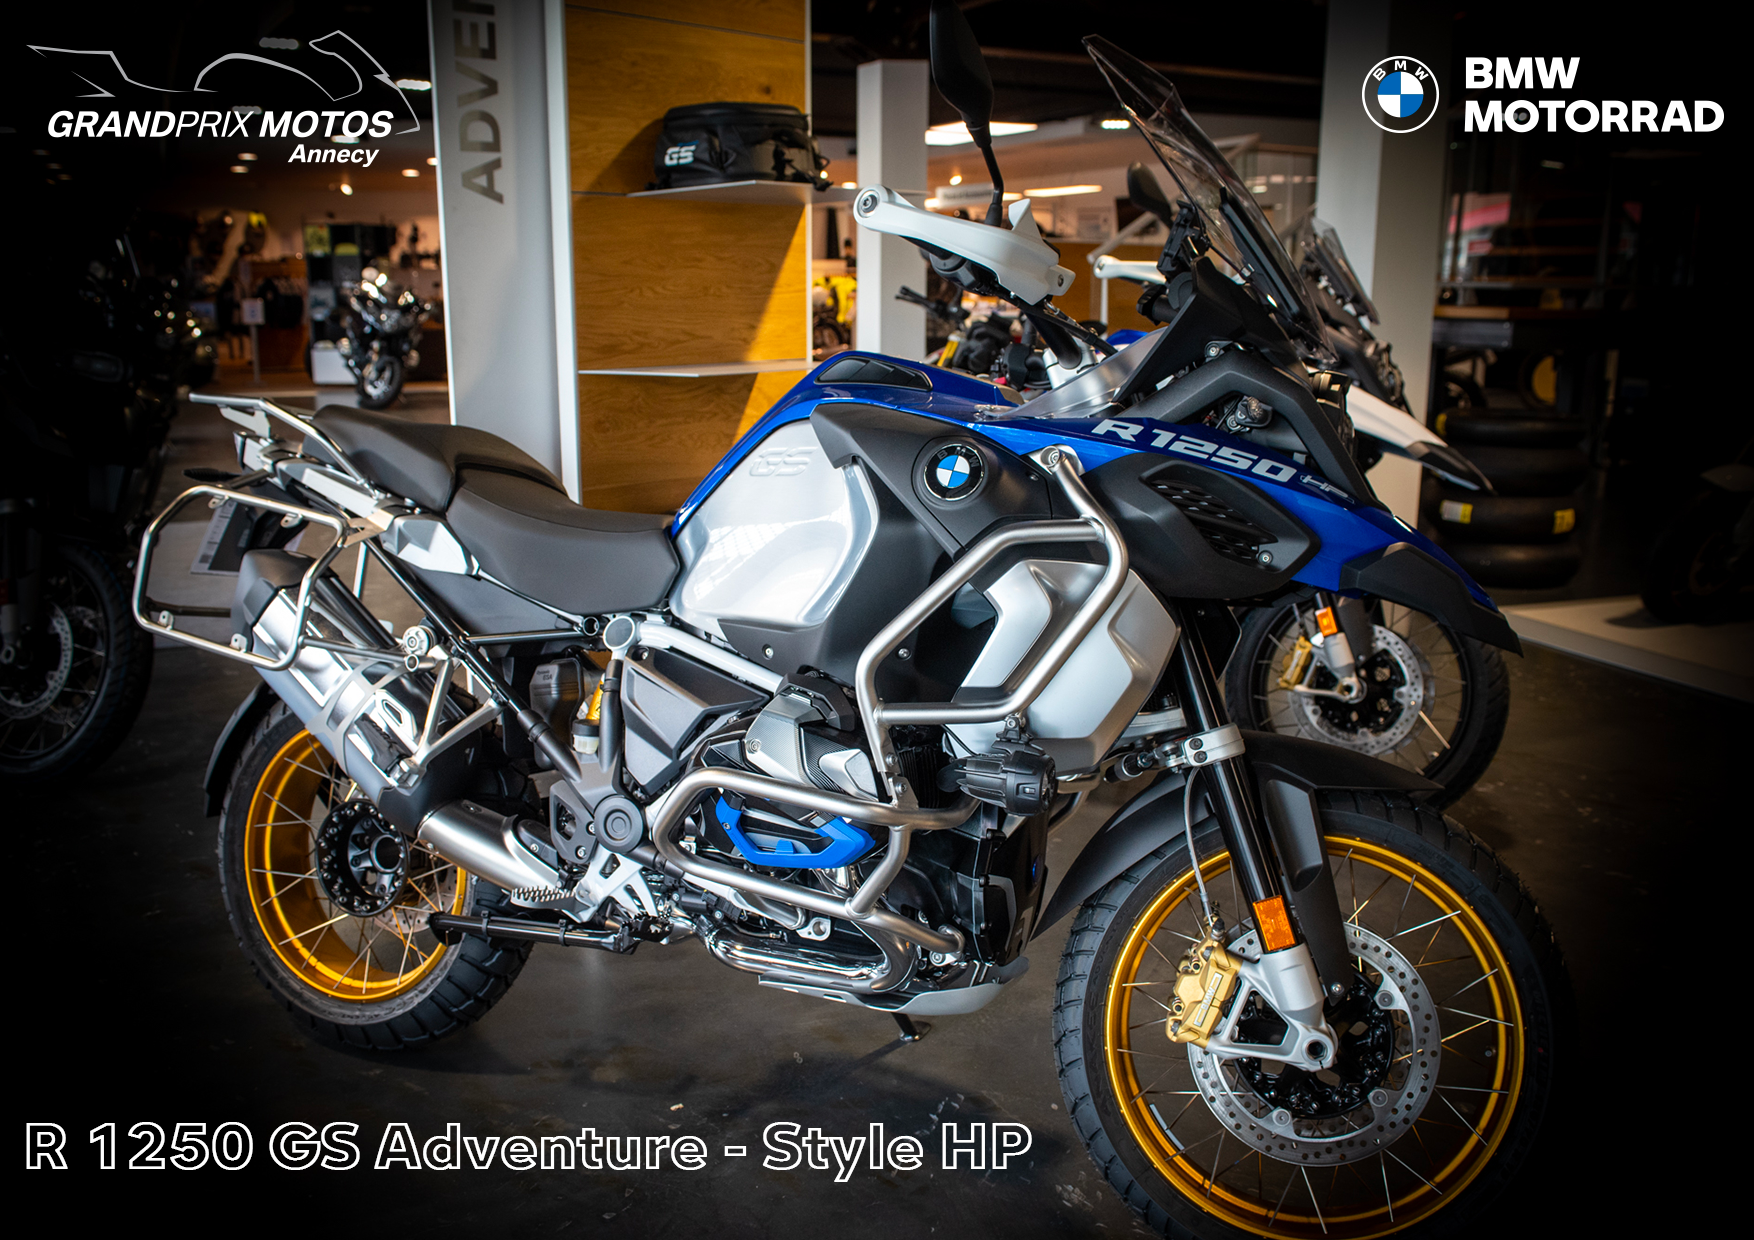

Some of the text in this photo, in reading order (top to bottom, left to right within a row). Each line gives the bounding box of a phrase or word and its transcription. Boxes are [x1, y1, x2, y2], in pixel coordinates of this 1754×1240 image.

[664, 145, 697, 167] GS
[749, 446, 819, 477] GS
[936, 446, 980, 468] BMW
[1091, 418, 1145, 442] R
[1150, 428, 1298, 483] 1250
[1200, 985, 1216, 1011] BMW
